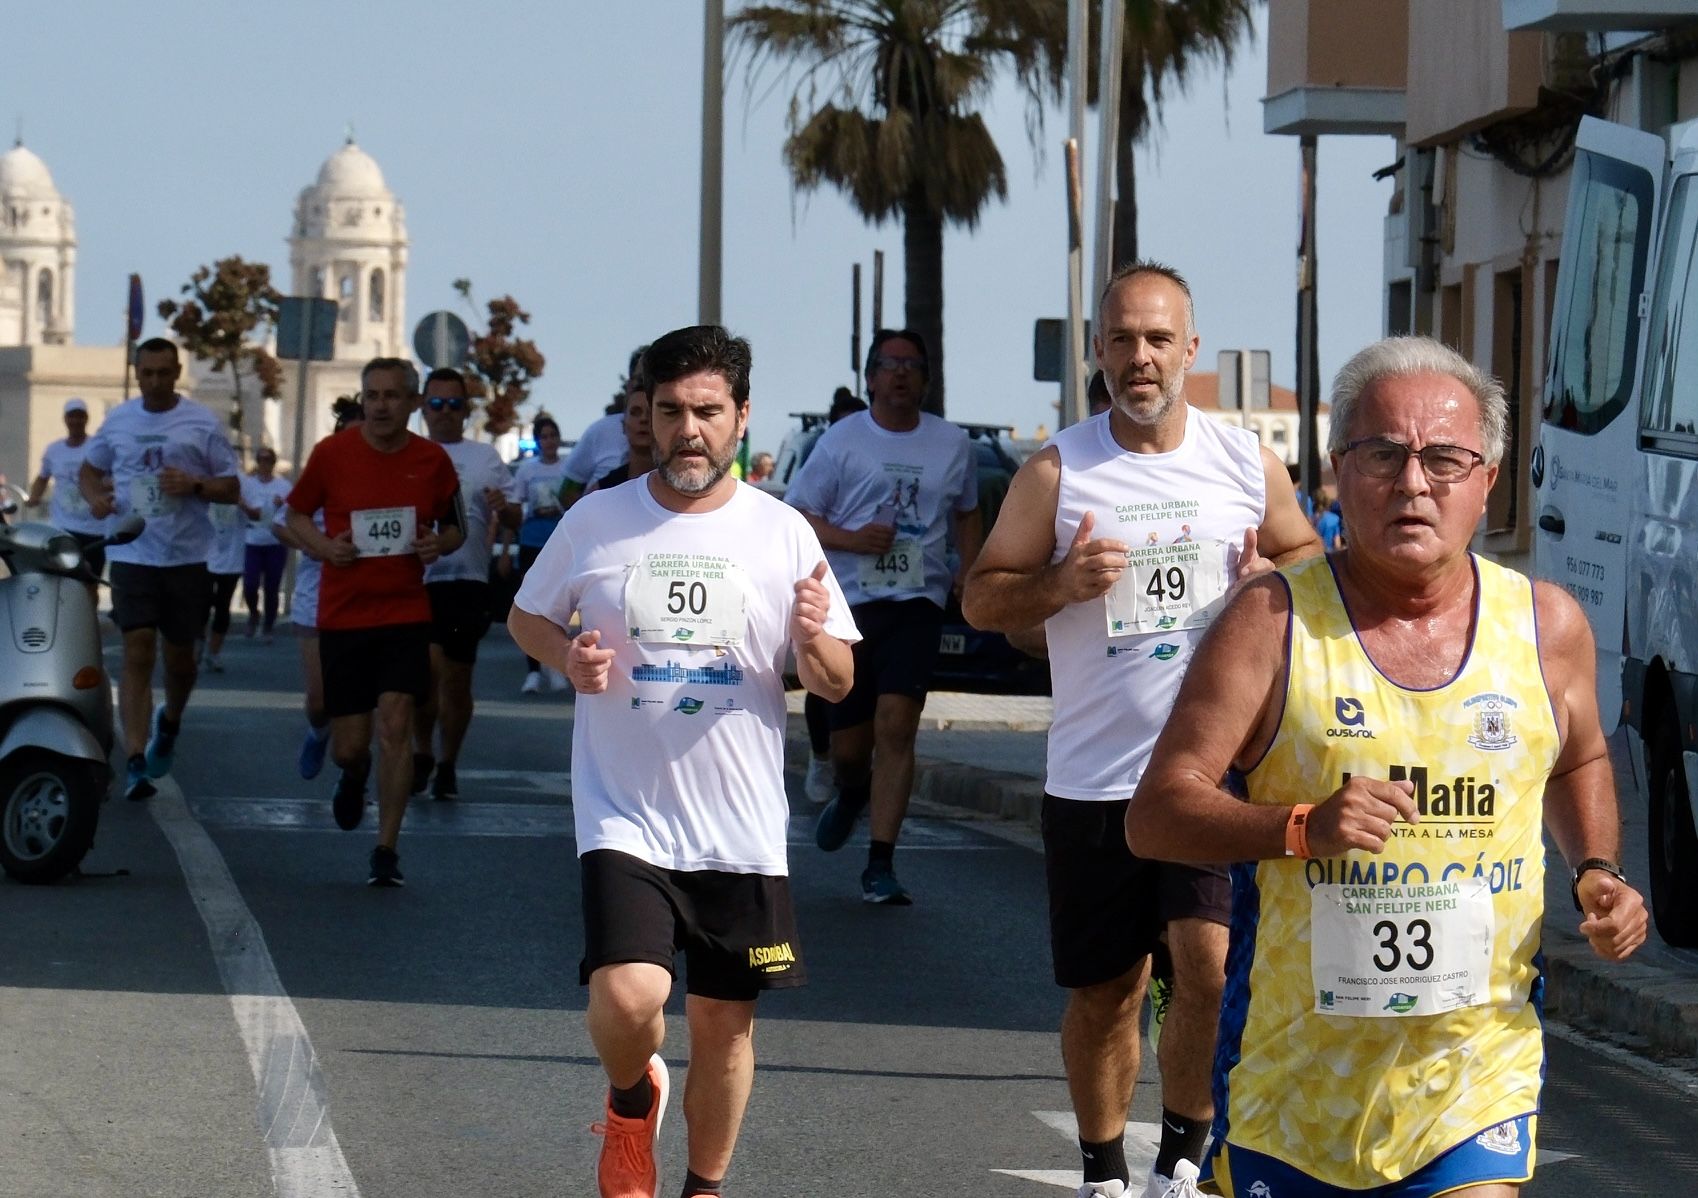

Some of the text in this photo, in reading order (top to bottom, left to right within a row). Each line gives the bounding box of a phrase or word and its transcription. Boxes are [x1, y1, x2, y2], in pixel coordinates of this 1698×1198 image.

[1115, 500, 1200, 513] CARRERA URBANA
[1118, 509, 1198, 523] SAN FELIPE NERI
[368, 520, 402, 540] 449
[1123, 543, 1201, 559] CARRERA URBANA
[649, 560, 727, 570] CARRERA URBANA
[874, 554, 909, 573] 443
[1127, 553, 1199, 567] SAN FELIPE NERI
[671, 570, 700, 578] FELIPE
[703, 571, 724, 579] NERI
[1566, 556, 1605, 581] 956 077 773
[1146, 566, 1186, 602] 49
[667, 581, 707, 615] 50
[1590, 589, 1604, 606] 987
[1326, 728, 1376, 740] austral
[1389, 765, 1496, 817] Mafia
[1391, 828, 1494, 839] NTA A LA MESA
[1441, 852, 1524, 893] CÁDIZ
[1342, 883, 1460, 899] CARRERA URBANA
[1346, 898, 1457, 914] SAN FELIPE NERI
[1373, 918, 1434, 973] 33
[1338, 970, 1469, 985] FRANCISCO JOSE RODRIGUEZ CASTRO
